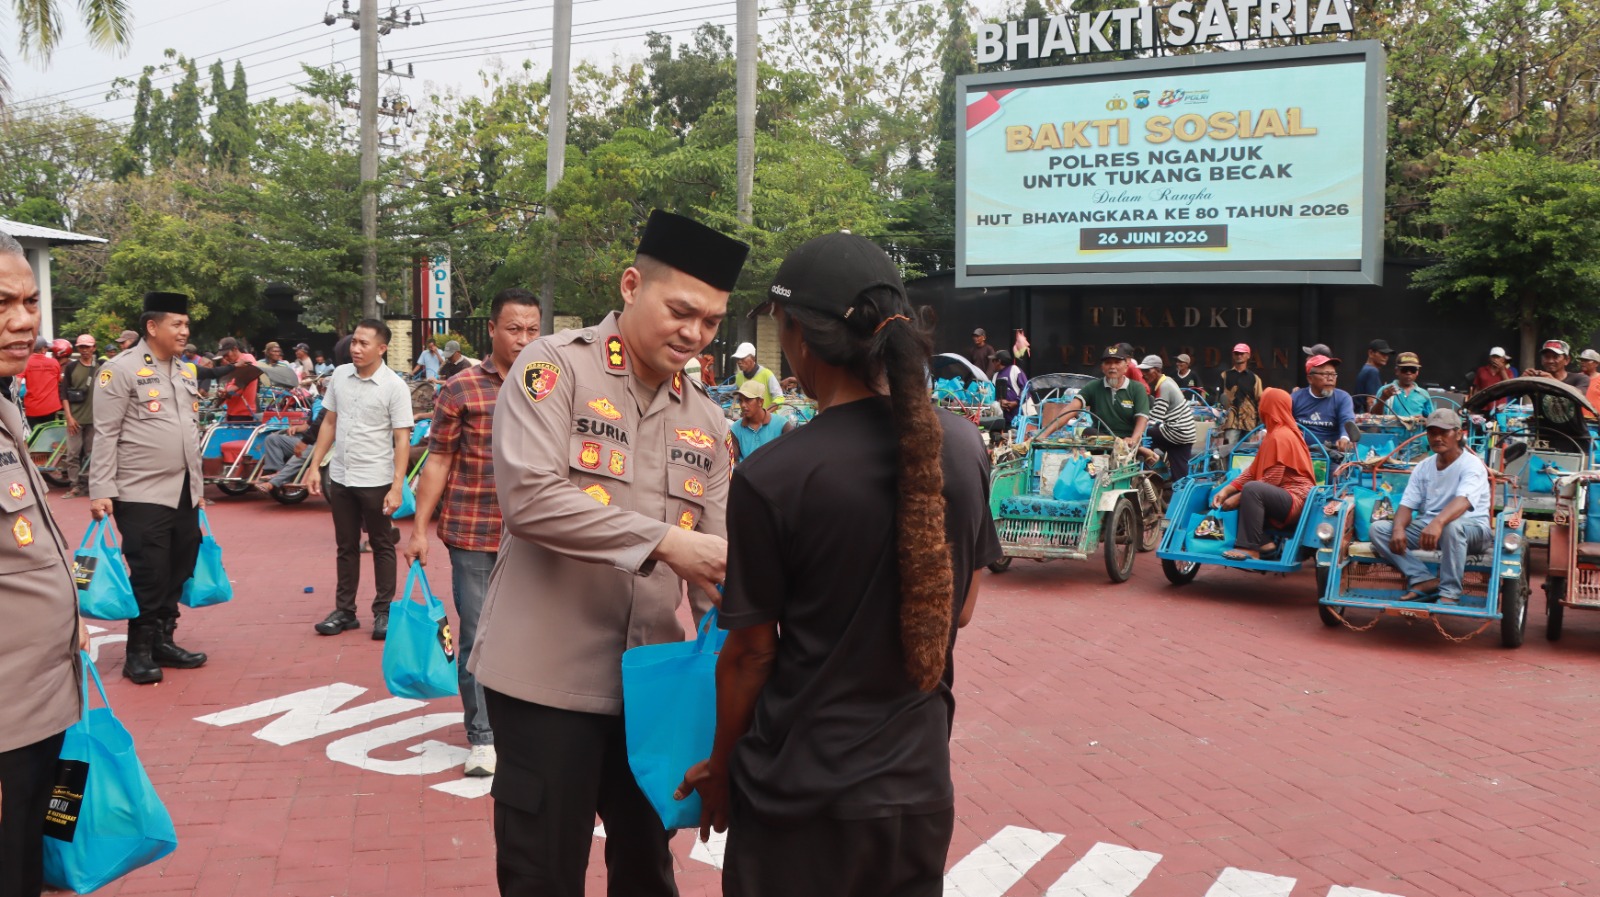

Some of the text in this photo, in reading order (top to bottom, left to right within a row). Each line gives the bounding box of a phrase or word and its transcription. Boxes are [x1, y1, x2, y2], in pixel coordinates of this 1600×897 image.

[976, 0, 1354, 64] BHAKTI SATRIA
[1005, 107, 1318, 152] BAKTI SOSIAL
[1049, 145, 1264, 170] POLRES NGANJUK
[1023, 163, 1293, 189] UNTUK TUKANG BECAK
[1092, 187, 1216, 205] Dalam Rangka
[977, 203, 1350, 226] HUT BHAYANGKARA KE 80 TAHUN 2026
[1098, 229, 1209, 246] 26 JUNI 2026
[771, 284, 792, 298] adidas
[1088, 306, 1255, 328] TEKADKU
[576, 417, 630, 446] SURIA
[670, 448, 714, 474] POLRI
